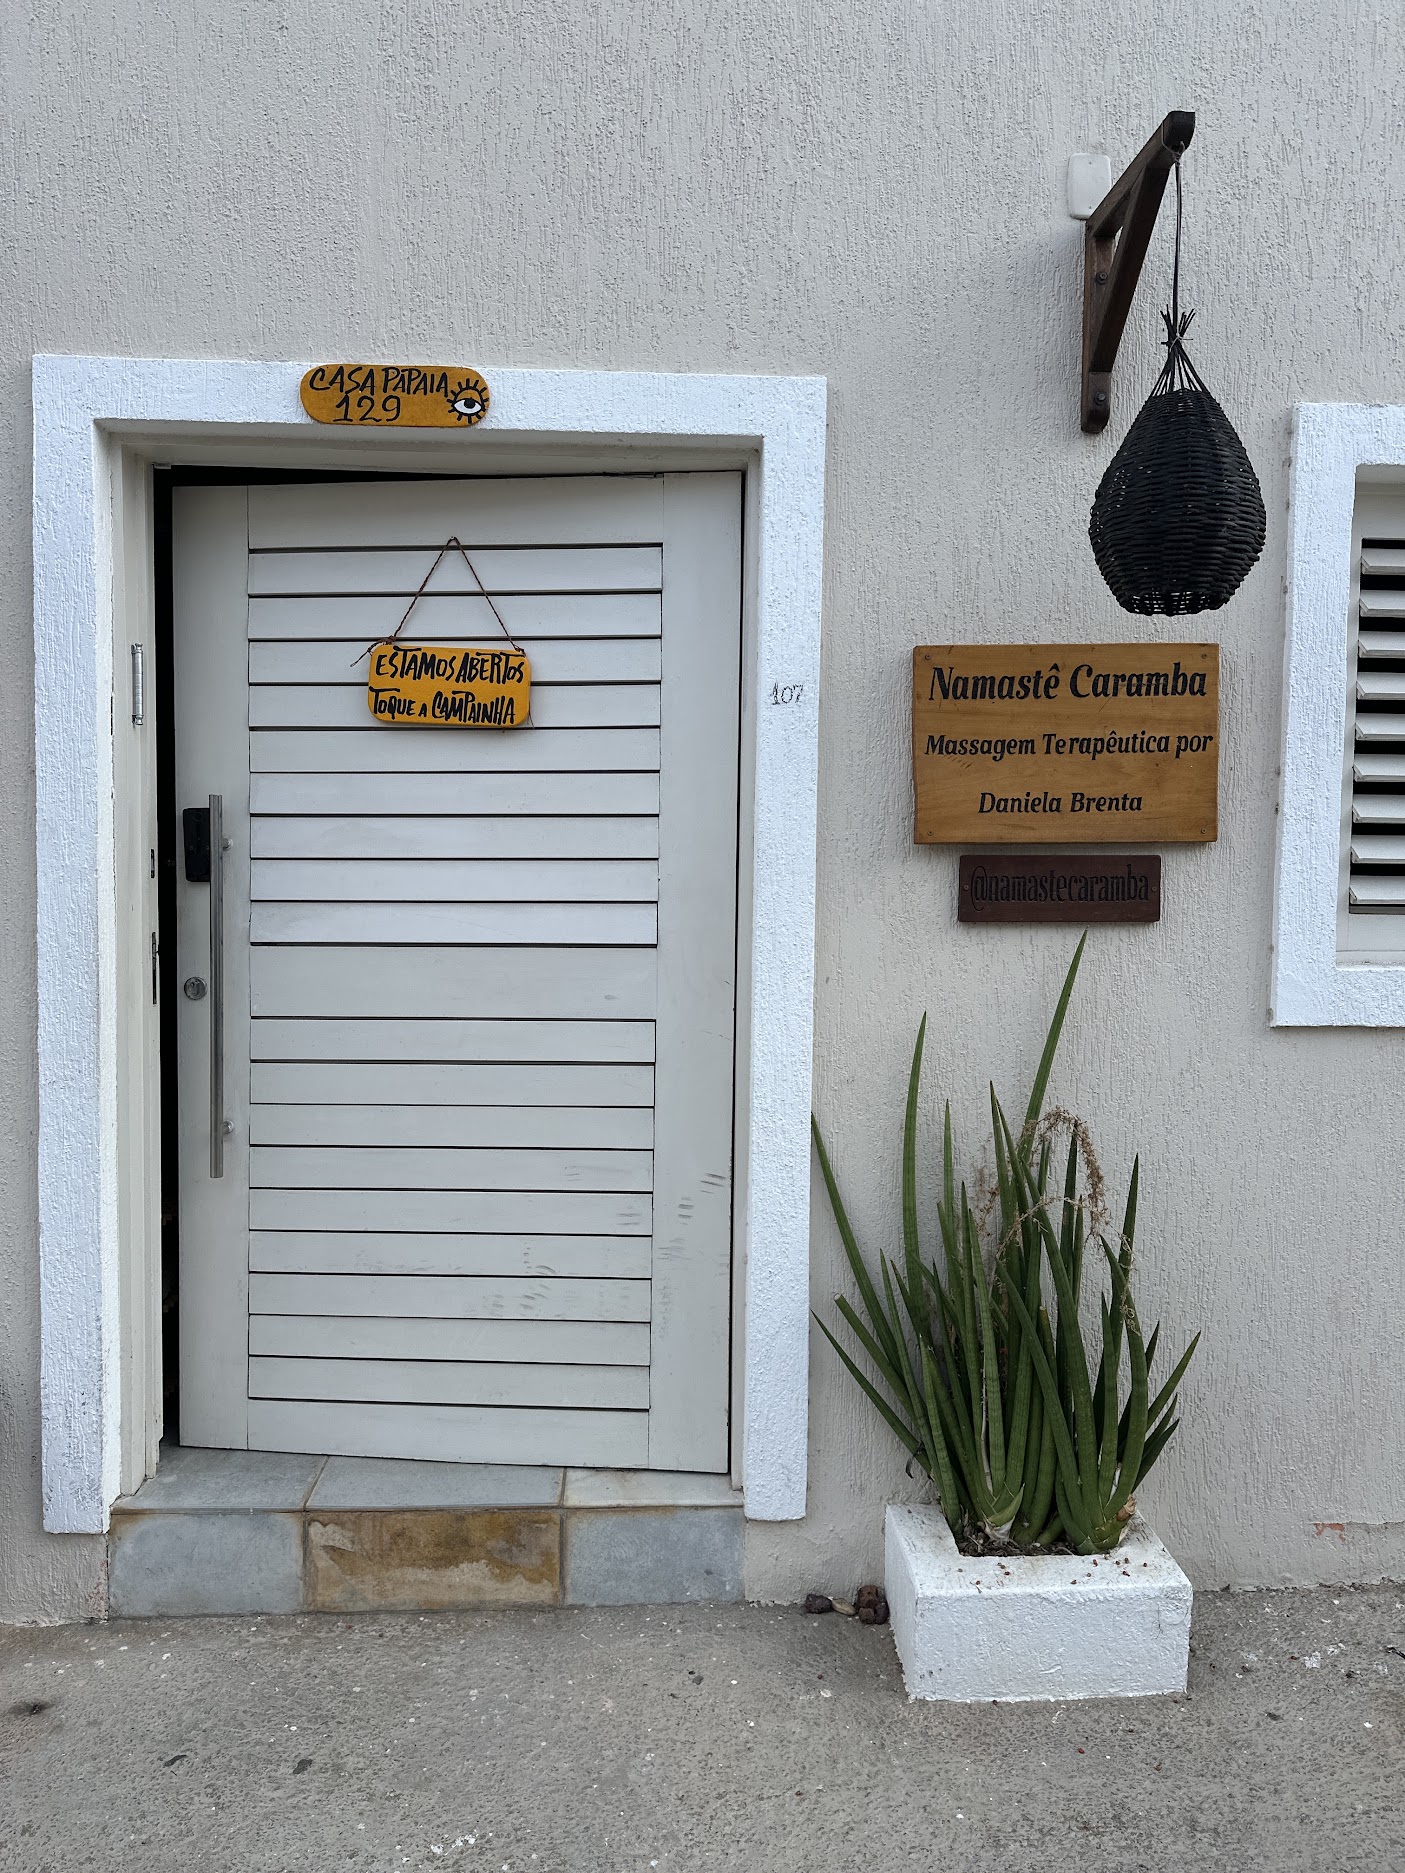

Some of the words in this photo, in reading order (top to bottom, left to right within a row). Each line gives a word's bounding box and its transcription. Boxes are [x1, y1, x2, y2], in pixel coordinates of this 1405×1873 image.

[309, 366, 375, 396] CASA
[381, 366, 449, 398] PAPAIA
[332, 395, 401, 423] 129
[375, 646, 457, 682] ESTAMOS
[771, 681, 804, 706] 107
[928, 662, 1061, 701] Namastê
[1069, 661, 1208, 699] Caramba
[924, 734, 1036, 762] Massagem
[1042, 730, 1170, 761] Terapêutica
[1174, 734, 1214, 760] por
[977, 791, 1062, 814] Daniela
[1069, 791, 1143, 813] Brenta
[970, 863, 1150, 912] @namastecaramba
